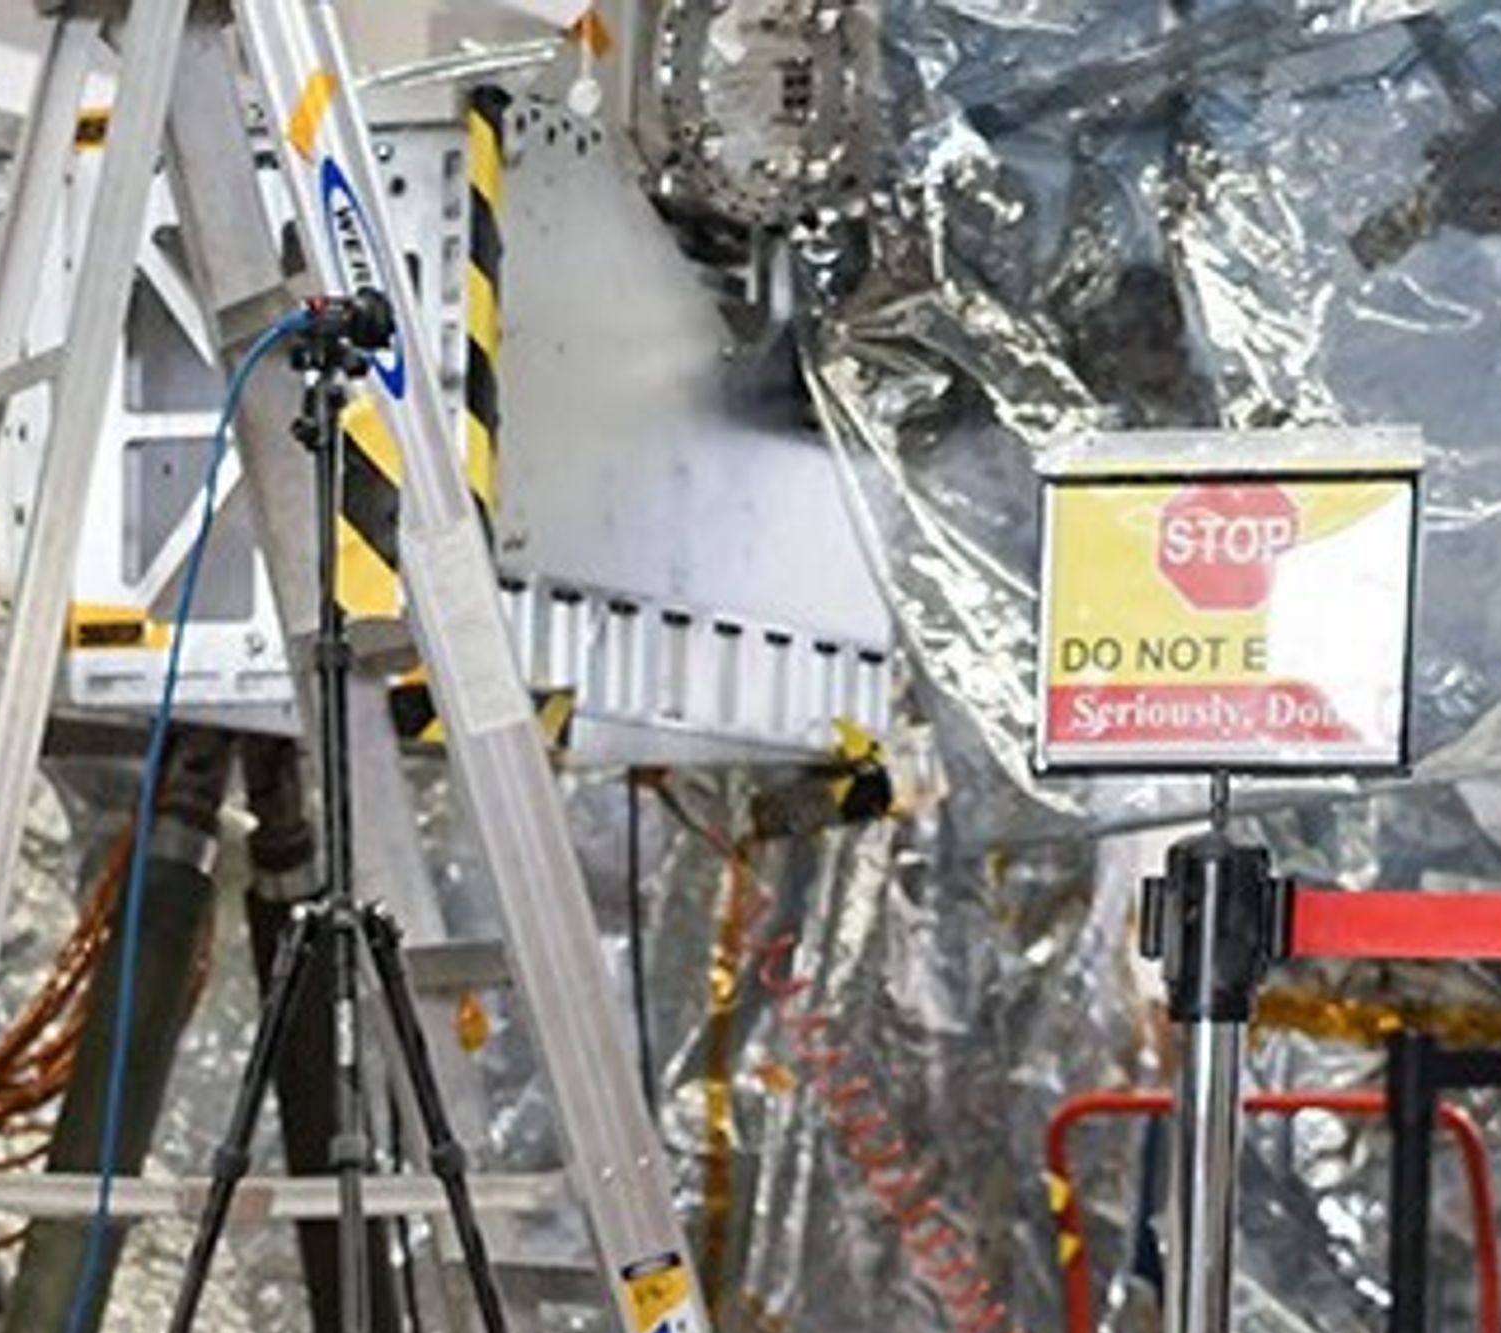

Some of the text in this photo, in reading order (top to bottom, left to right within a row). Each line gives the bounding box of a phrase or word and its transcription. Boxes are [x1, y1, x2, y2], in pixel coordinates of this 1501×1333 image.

[1163, 515, 1291, 565] STOP
[1061, 637, 1122, 672] DO
[1135, 635, 1227, 671] NOT
[1265, 692, 1339, 728] Don
